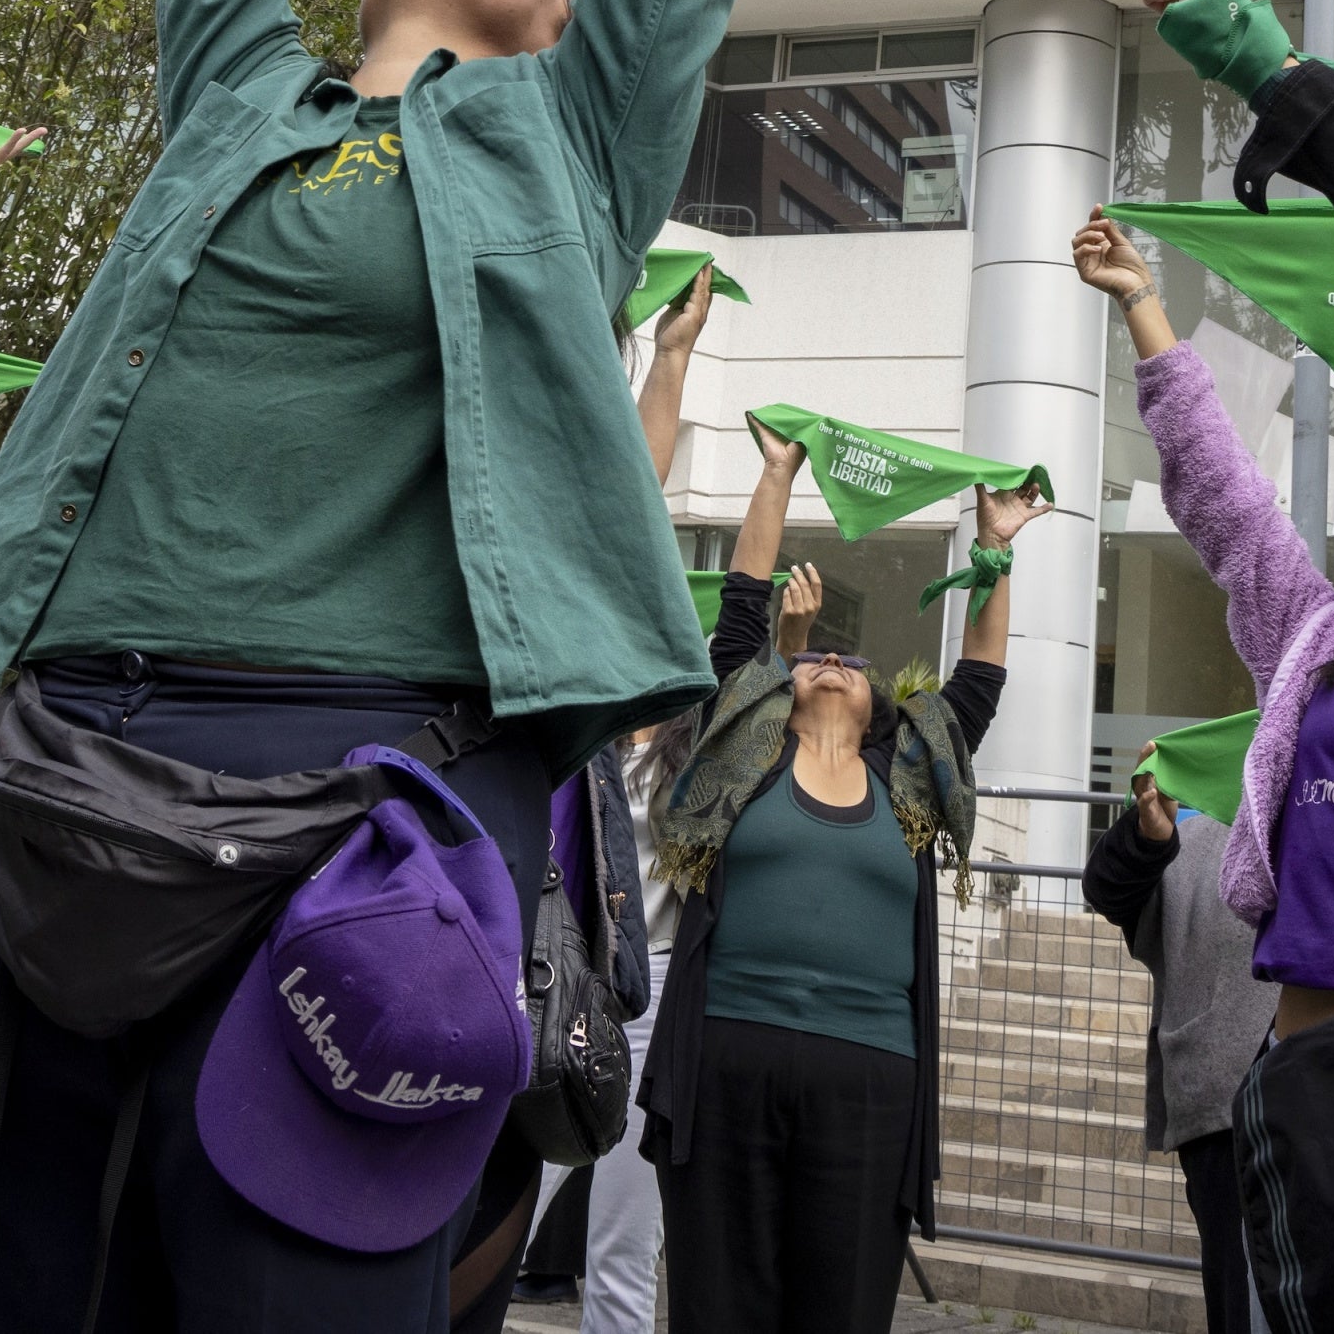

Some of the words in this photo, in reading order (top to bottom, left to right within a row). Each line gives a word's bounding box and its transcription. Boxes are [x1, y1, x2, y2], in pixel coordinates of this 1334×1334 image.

[818, 422, 833, 435] Que
[835, 430, 843, 438] el
[844, 434, 869, 448] aborto
[871, 444, 881, 452] no
[883, 448, 896, 458] sea
[898, 454, 908, 463] un
[910, 457, 934, 472] delito
[842, 446, 887, 476] JUSTA
[829, 460, 892, 496] LIBERTAD
